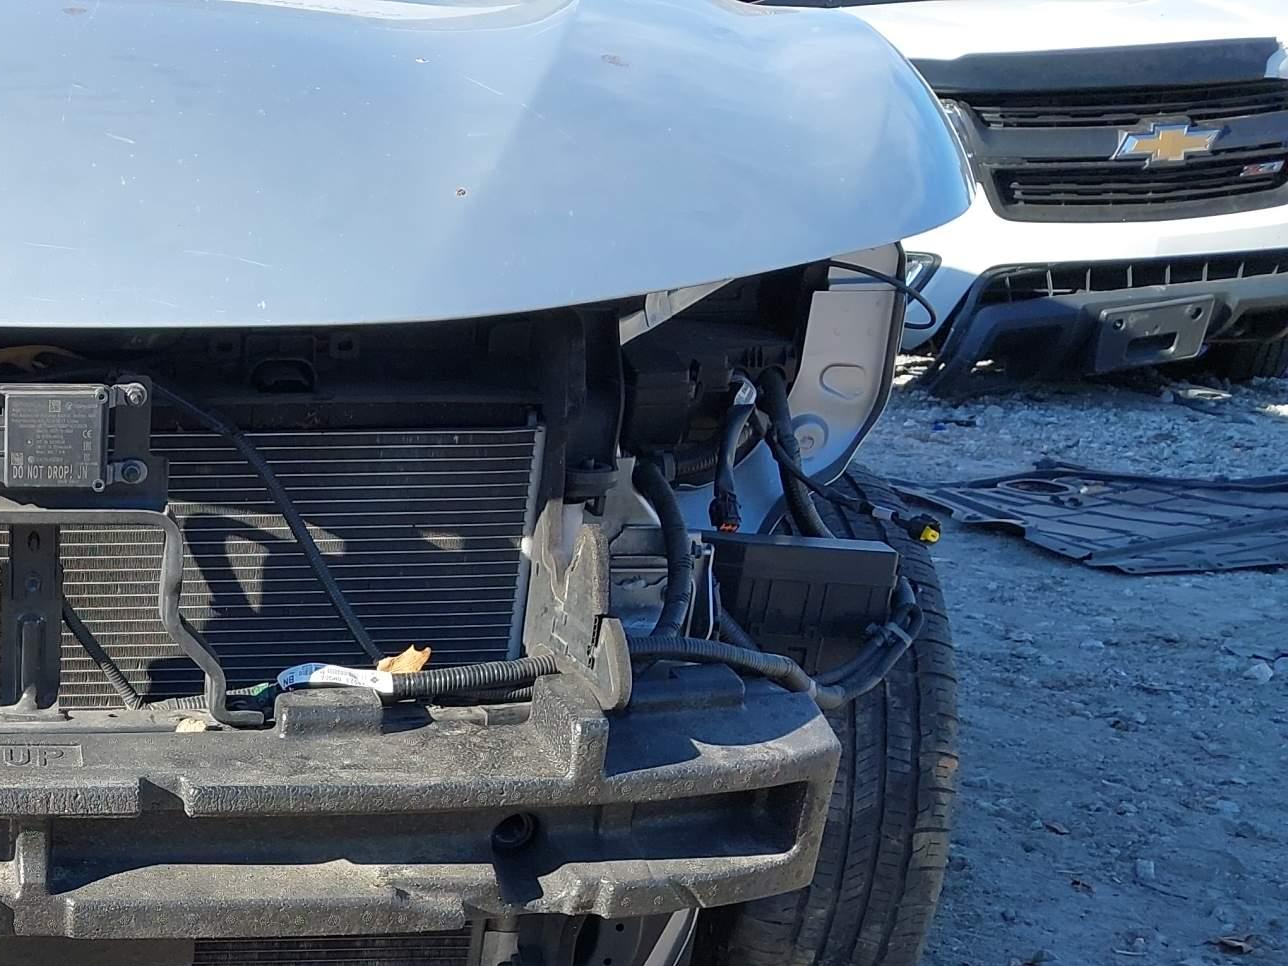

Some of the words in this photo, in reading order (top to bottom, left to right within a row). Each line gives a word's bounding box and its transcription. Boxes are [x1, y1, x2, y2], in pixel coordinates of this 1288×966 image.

[12, 465, 24, 479] DO
[27, 465, 45, 479] NOT
[47, 464, 73, 479] DROP!
[3, 748, 64, 767] UP
